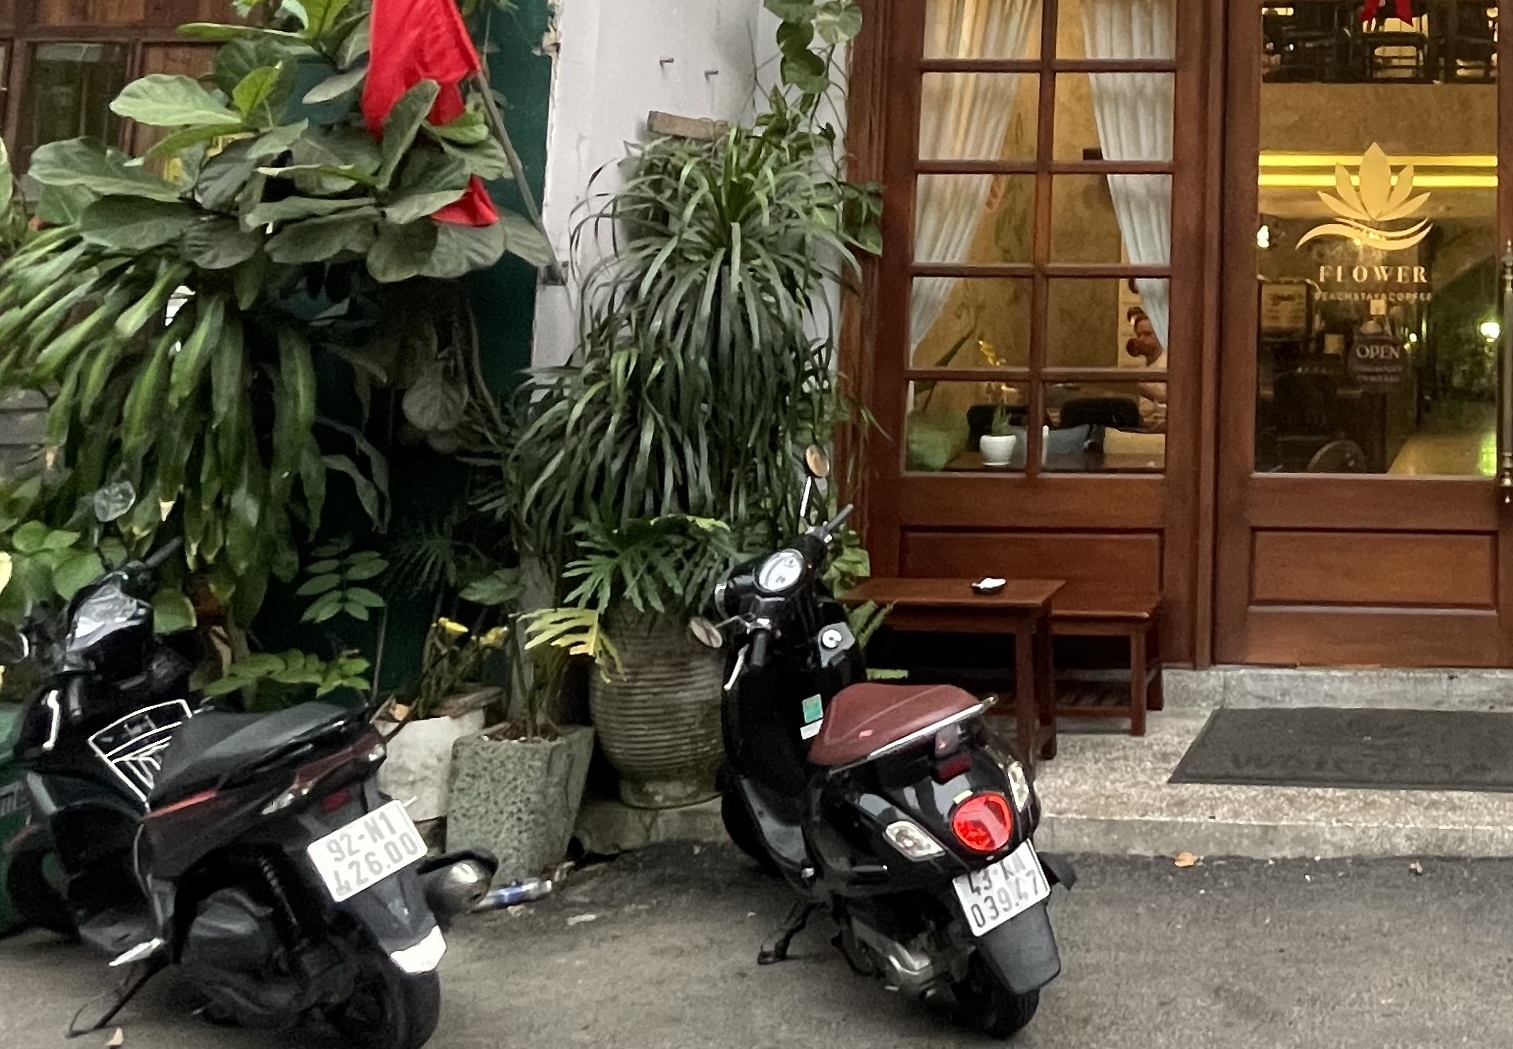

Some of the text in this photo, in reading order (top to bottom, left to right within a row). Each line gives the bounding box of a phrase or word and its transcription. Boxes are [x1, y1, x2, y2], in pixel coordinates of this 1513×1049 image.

[1319, 265, 1428, 284] FLOWER
[1356, 344, 1400, 360] OPEN
[325, 811, 398, 862] 92-N1
[333, 833, 419, 897] 426.00
[970, 869, 1038, 929] 039.47
